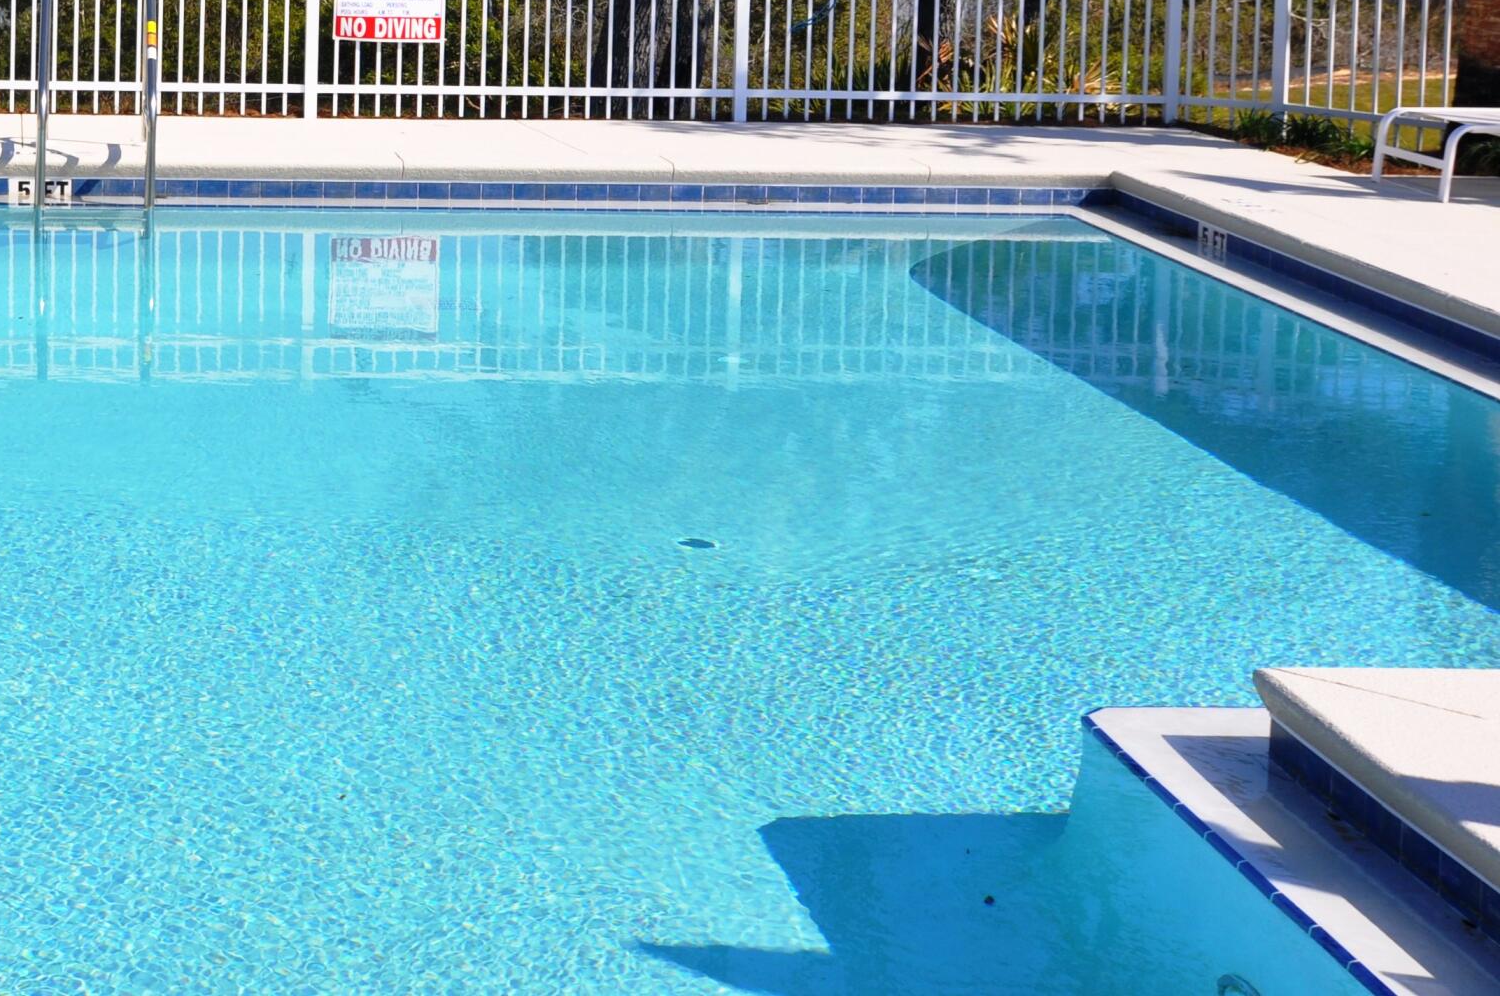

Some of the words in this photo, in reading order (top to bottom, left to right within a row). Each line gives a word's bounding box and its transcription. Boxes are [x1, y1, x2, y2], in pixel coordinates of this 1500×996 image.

[340, 17, 367, 38] NO
[374, 17, 437, 39] DIVING
[18, 180, 31, 196] 5
